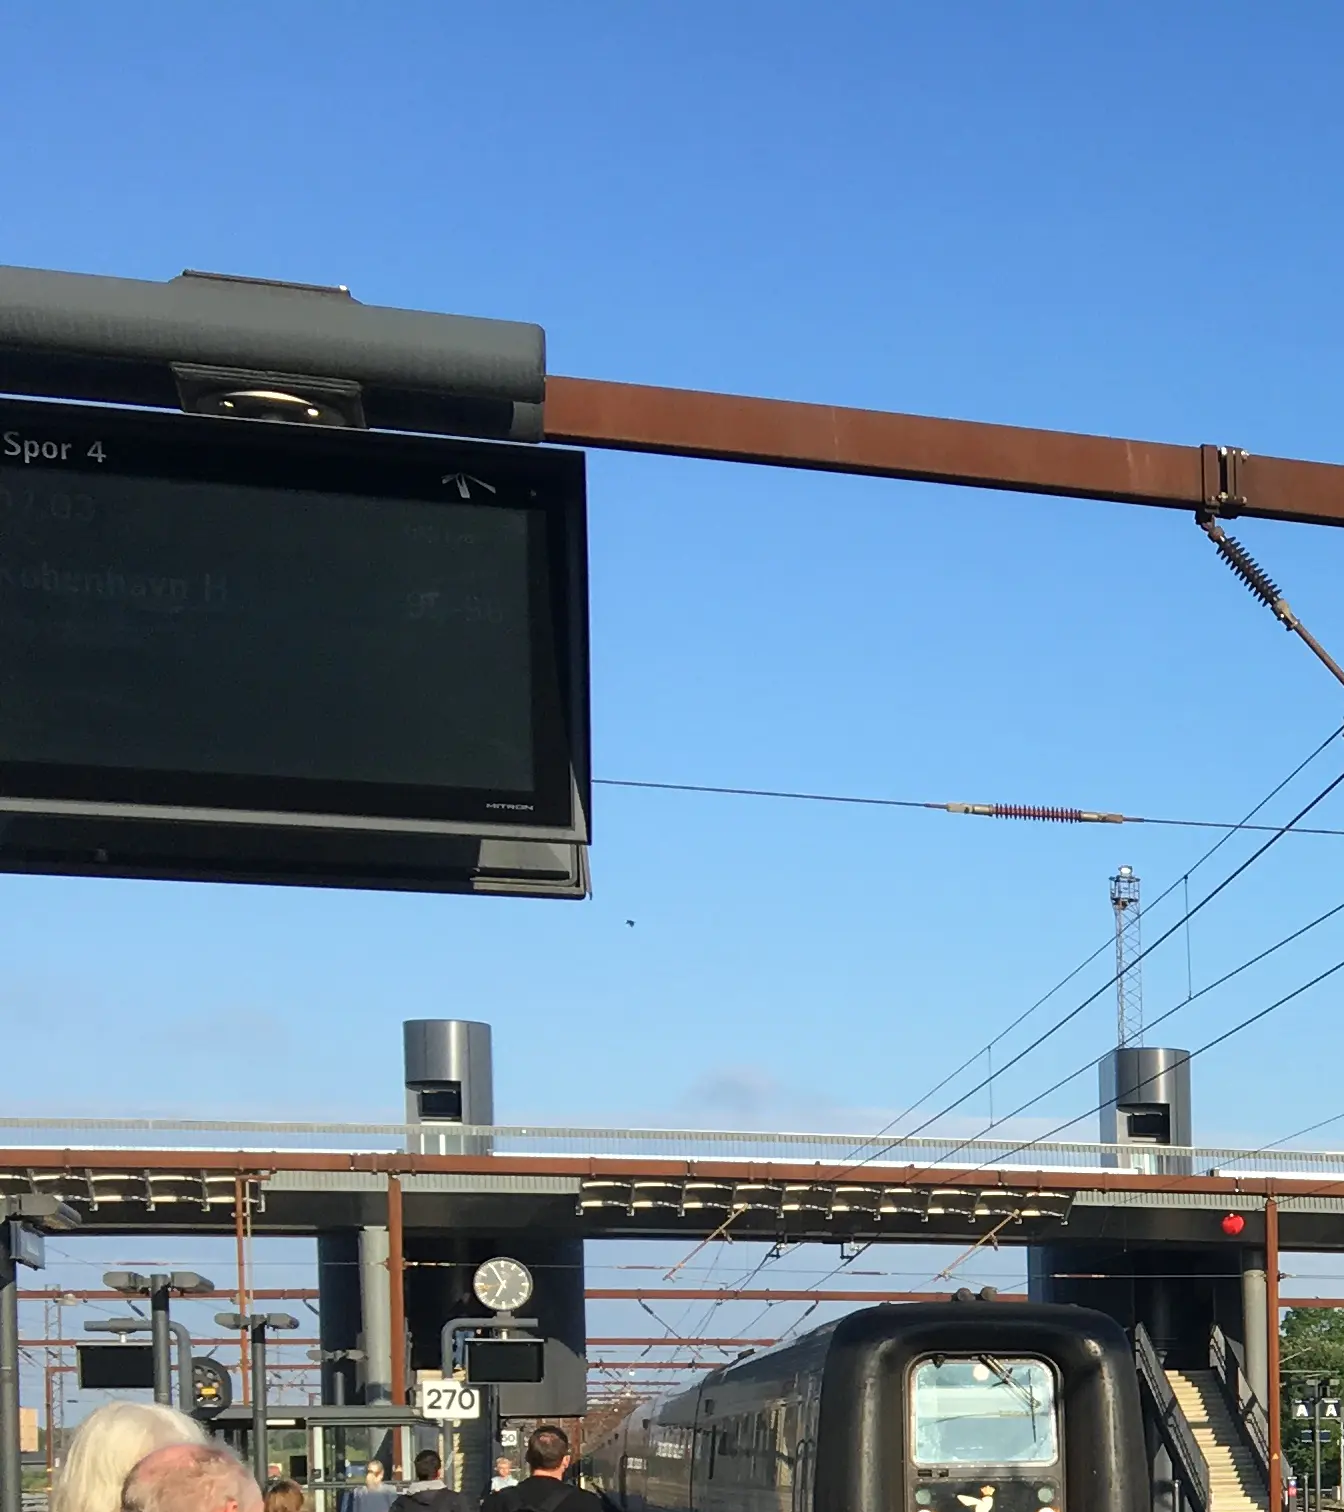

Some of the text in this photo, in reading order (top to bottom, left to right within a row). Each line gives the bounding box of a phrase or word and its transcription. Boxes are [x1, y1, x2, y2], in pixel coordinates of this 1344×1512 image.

[3, 430, 107, 464] Spor 4
[426, 1388, 475, 1410] 270
[1296, 1404, 1308, 1417] A
[1325, 1404, 1338, 1417] A
